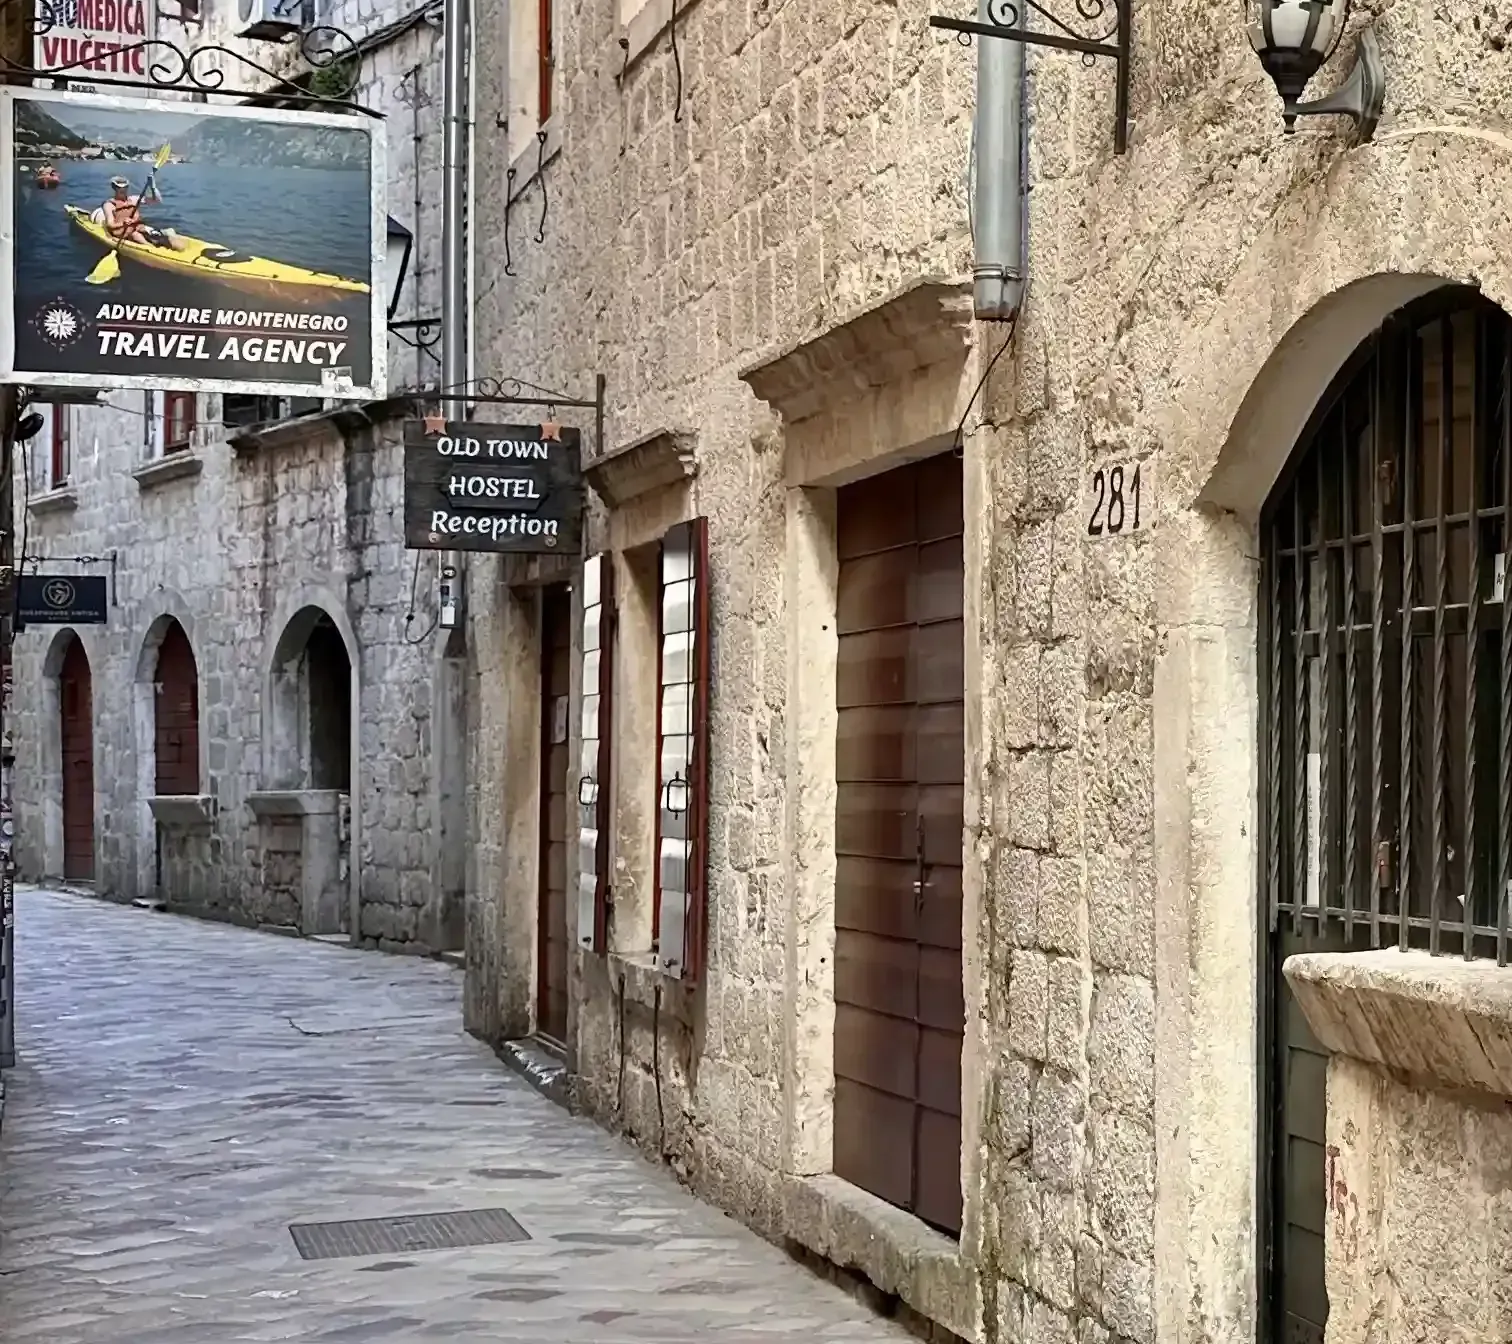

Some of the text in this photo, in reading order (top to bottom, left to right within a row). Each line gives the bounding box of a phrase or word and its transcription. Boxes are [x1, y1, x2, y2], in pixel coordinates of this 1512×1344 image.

[95, 303, 349, 332] ADVENTURE MONTENEGRO
[97, 330, 347, 366] TRAVEL AGENCY
[436, 437, 549, 460] OLD TOWN
[448, 475, 541, 500] HOSTEL
[1087, 462, 1141, 536] 281
[430, 510, 559, 542] Reception
